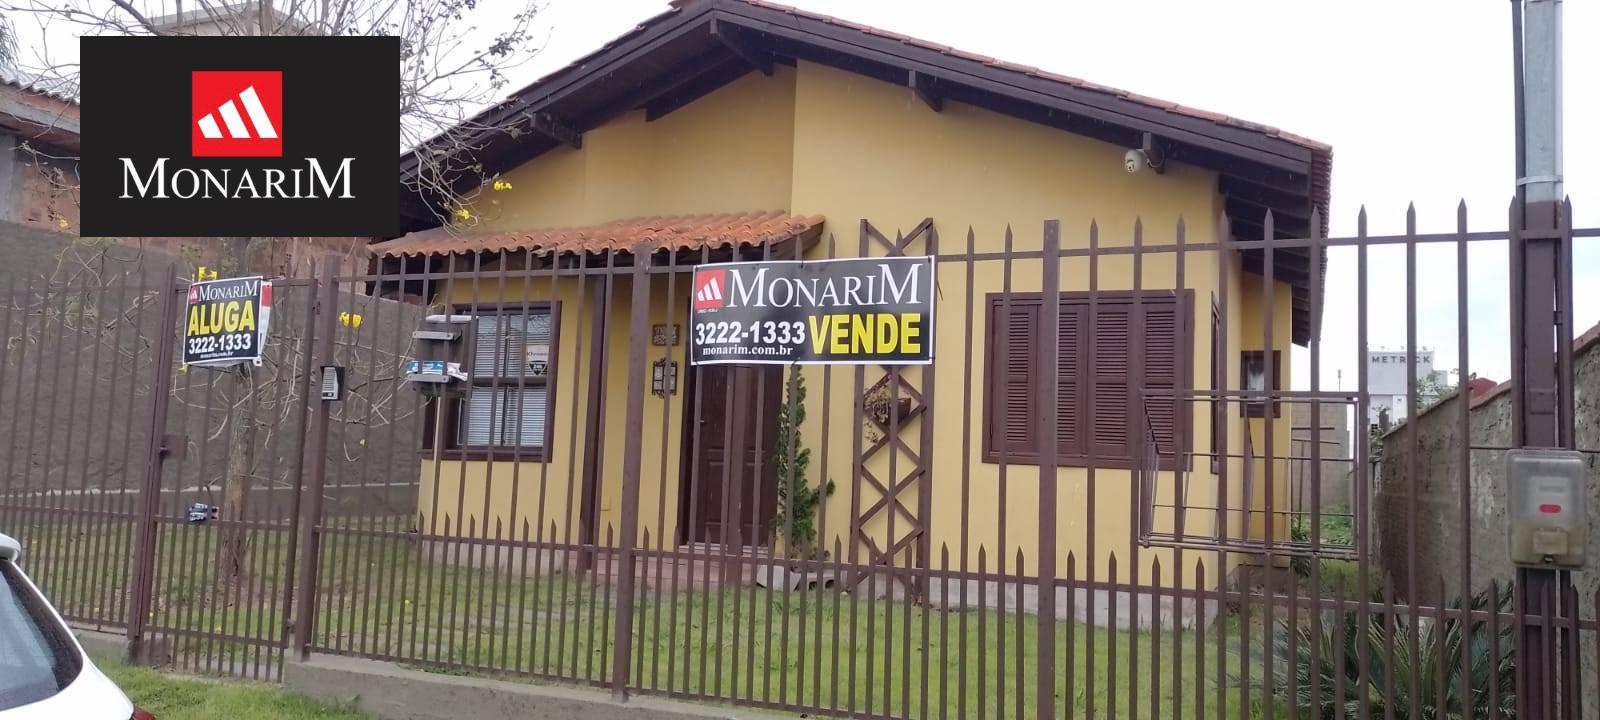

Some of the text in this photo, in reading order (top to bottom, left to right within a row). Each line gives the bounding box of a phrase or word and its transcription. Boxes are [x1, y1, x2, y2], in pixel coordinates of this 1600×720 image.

[187, 300, 255, 337] ALUGA
[188, 333, 252, 354] 3222-1333
[695, 320, 806, 345] 3222-1333
[809, 313, 921, 354] VENDE
[702, 344, 794, 356] monarim.com.br
[1371, 355, 1431, 364] METRCK
